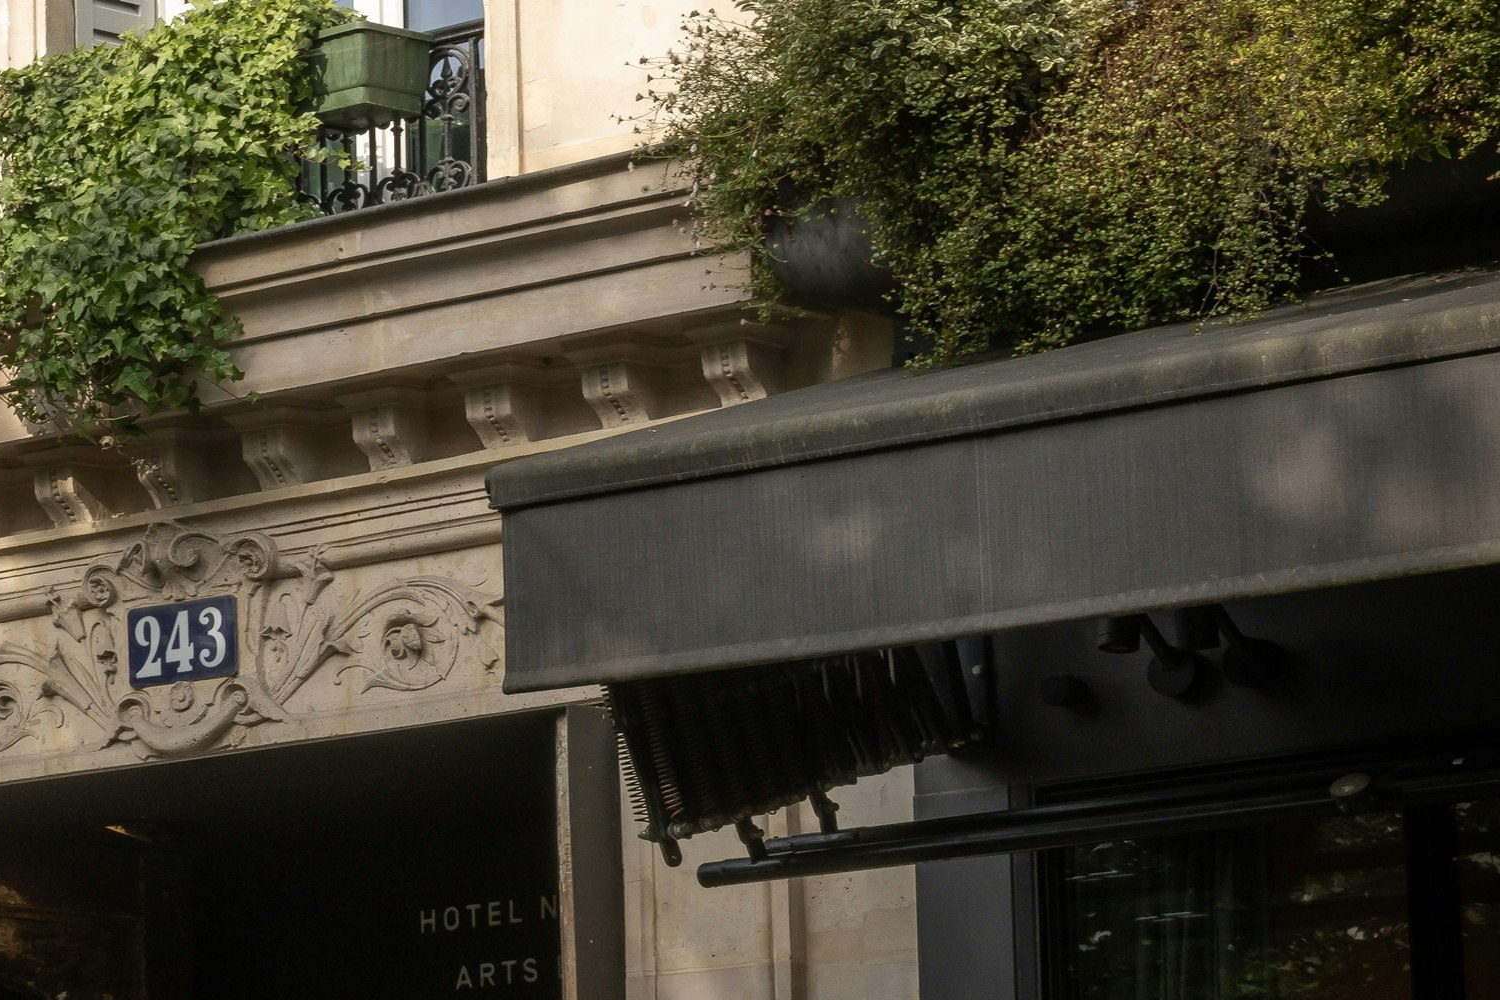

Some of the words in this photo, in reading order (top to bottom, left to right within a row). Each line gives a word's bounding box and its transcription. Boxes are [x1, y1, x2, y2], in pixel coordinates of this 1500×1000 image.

[135, 606, 226, 679] 243
[419, 899, 523, 934] HOTEL
[455, 957, 539, 990] ARTS
